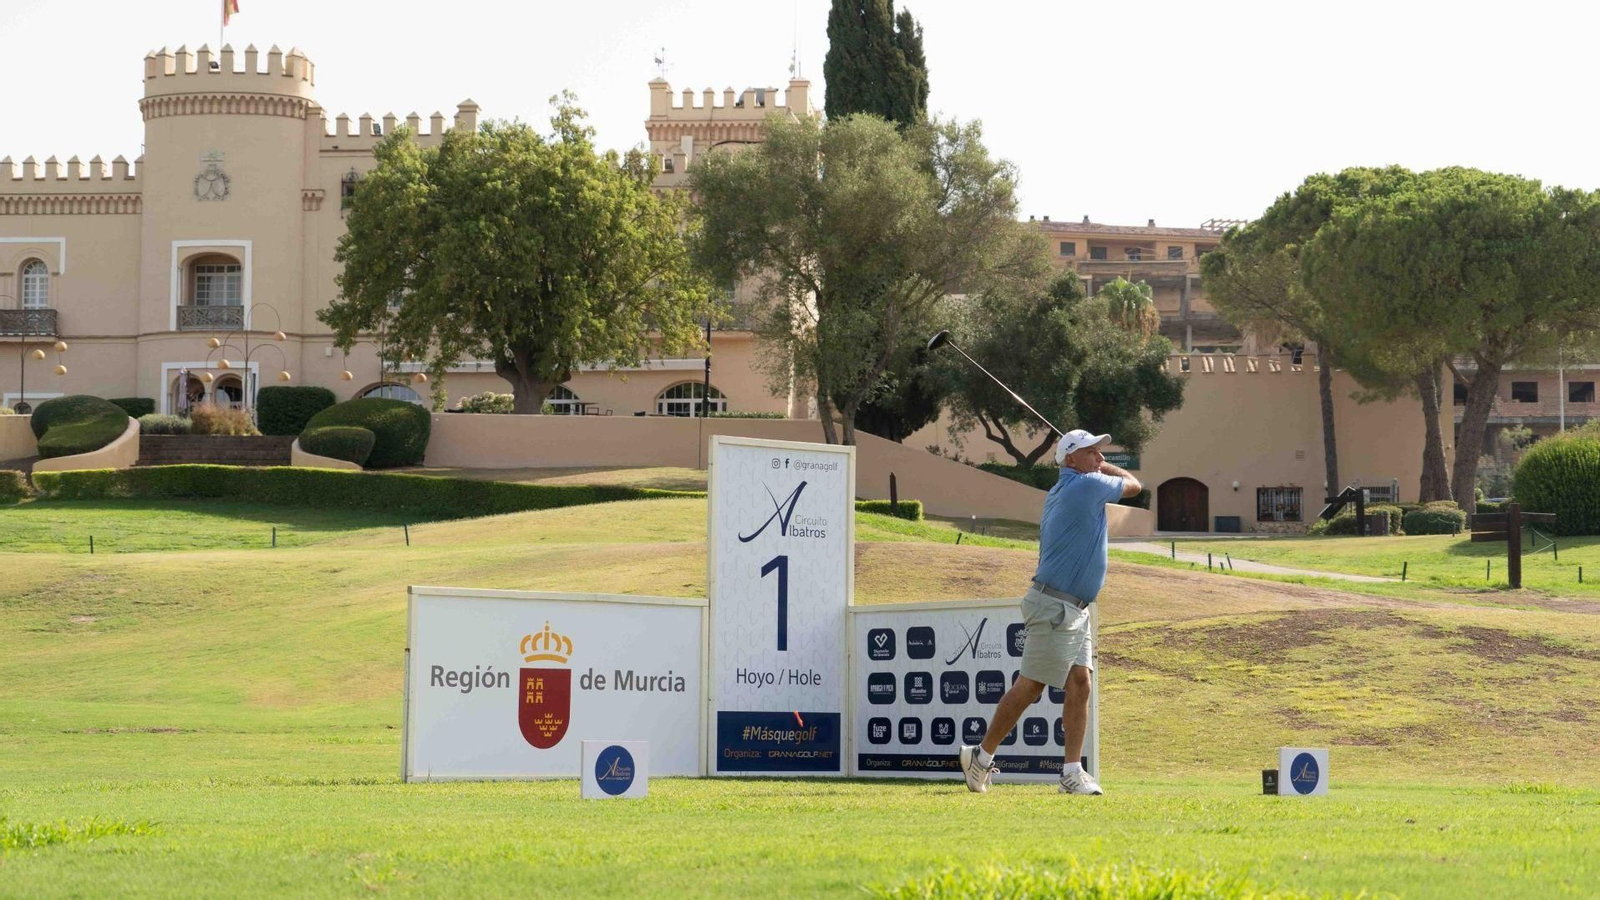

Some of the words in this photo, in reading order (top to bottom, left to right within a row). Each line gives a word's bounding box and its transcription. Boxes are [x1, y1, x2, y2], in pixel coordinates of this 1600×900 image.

[793, 459, 839, 473] @granagolf
[795, 514, 828, 527] Circuito
[761, 555, 788, 651] 1
[430, 665, 510, 694] Región
[580, 667, 607, 691] de
[614, 669, 686, 693] Murcia
[736, 668, 775, 688] Hoyo
[788, 669, 821, 686] Hole
[742, 726, 817, 744] #Másquegolf
[724, 748, 762, 760] Organiza:
[1039, 760, 1064, 772] #Másqu
